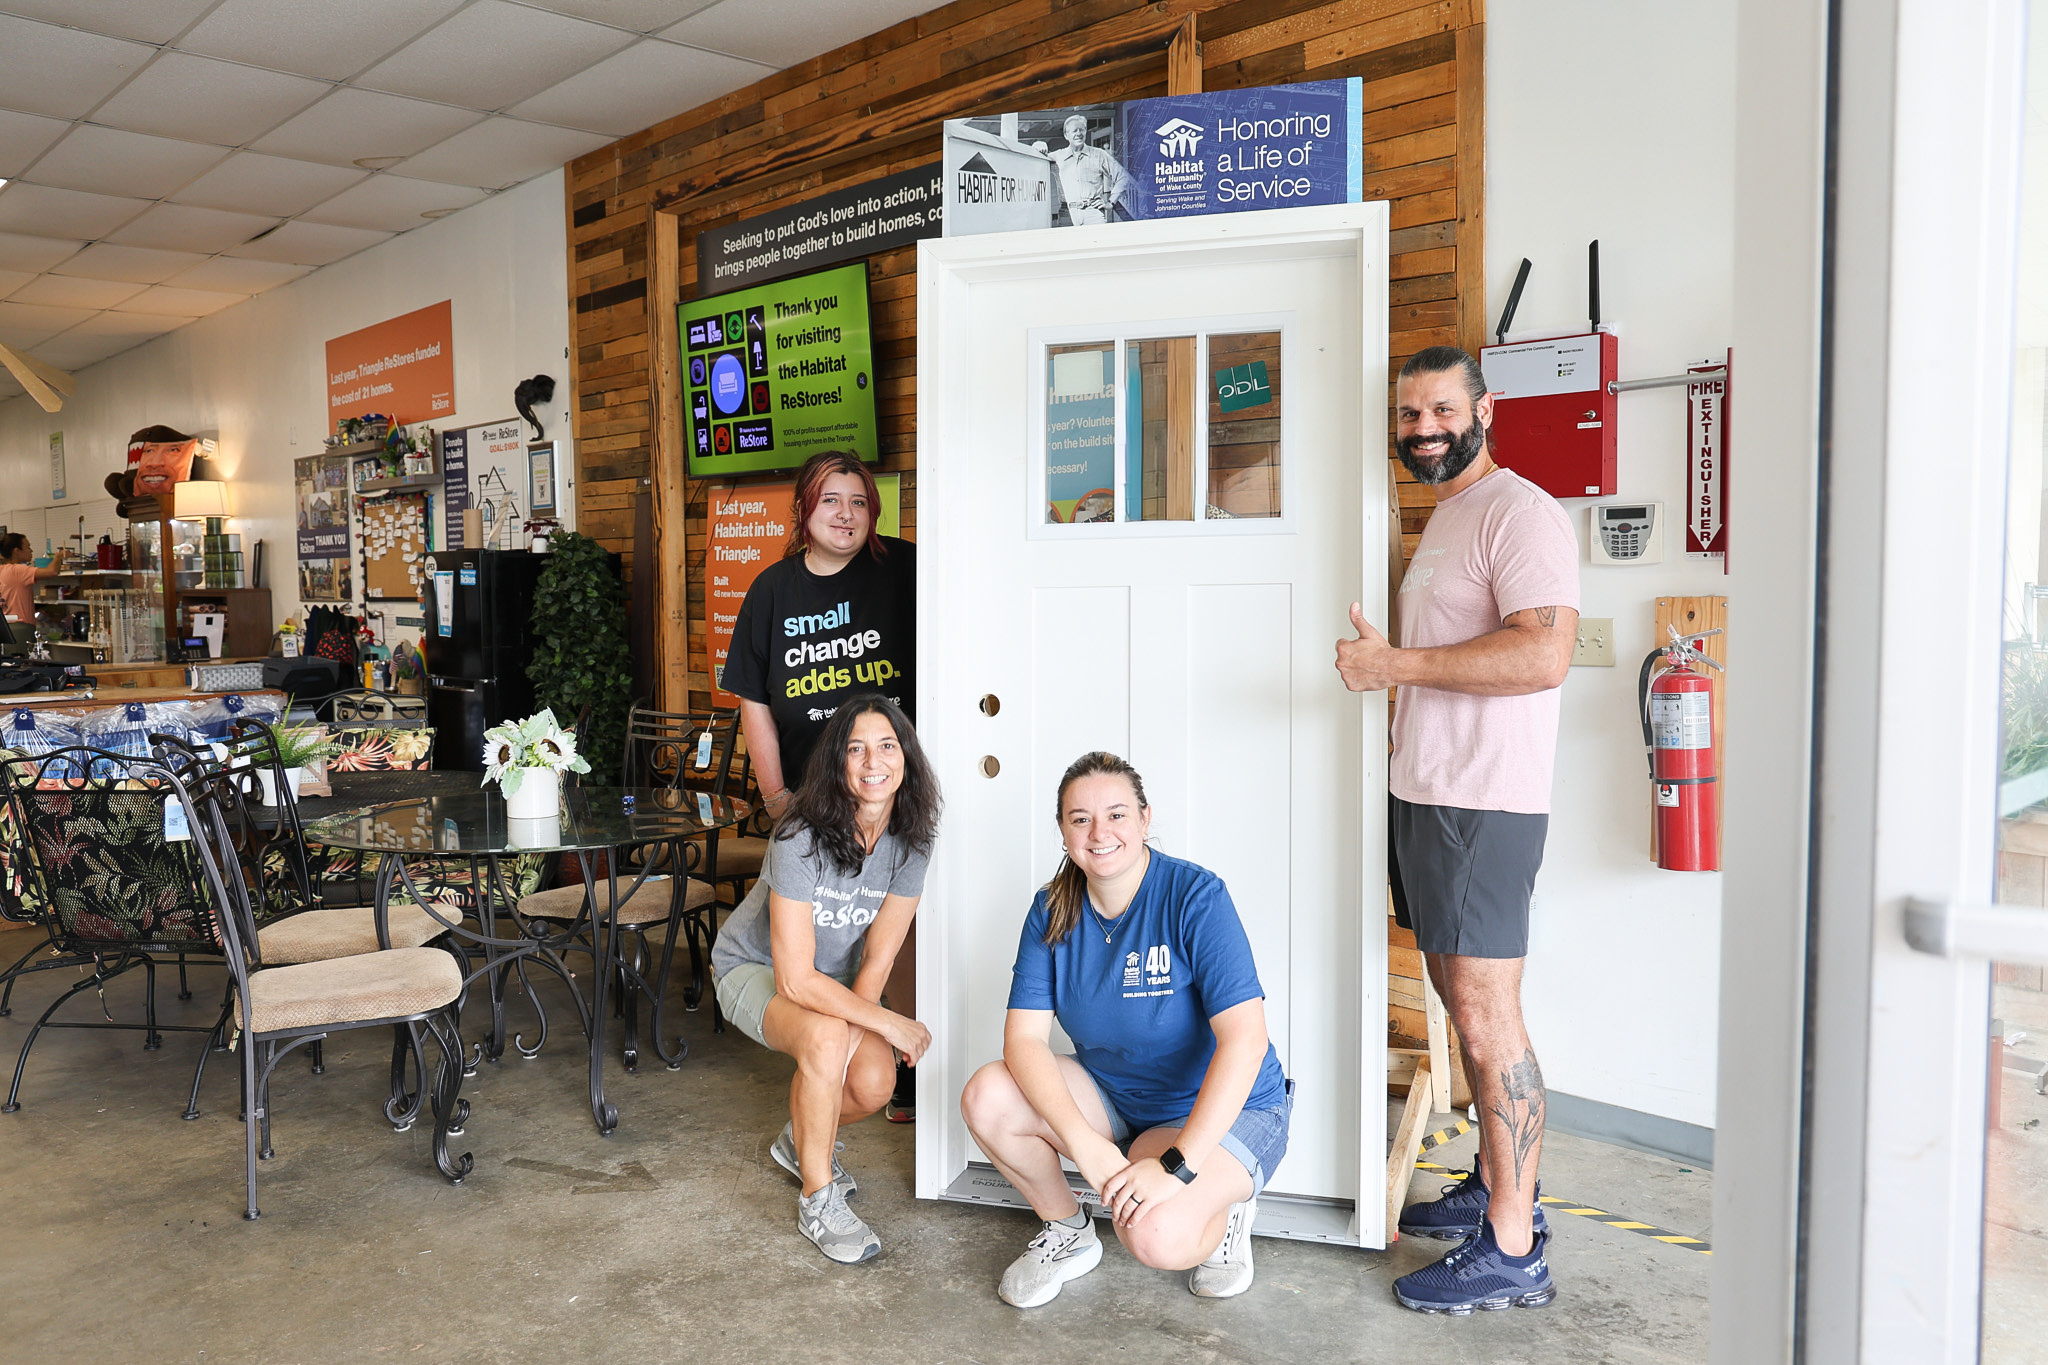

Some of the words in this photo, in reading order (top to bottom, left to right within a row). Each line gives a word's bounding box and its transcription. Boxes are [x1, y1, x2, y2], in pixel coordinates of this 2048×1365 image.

[1218, 112, 1330, 142] Honoring
[1156, 160, 1204, 176] Habitat
[1217, 154, 1233, 172] a
[1238, 145, 1282, 171] Life
[1287, 141, 1312, 166] of
[958, 172, 997, 204] HABITAT
[1001, 177, 1016, 203] FOR
[1018, 178, 1047, 203] HUMANITY
[1217, 175, 1310, 202] Service
[723, 231, 762, 255] Seeking
[764, 228, 776, 243] to
[777, 220, 795, 242] put
[830, 203, 854, 224] love
[857, 197, 881, 216] into
[884, 184, 928, 209] action,
[931, 177, 943, 196] H
[714, 258, 744, 279] brings
[746, 248, 780, 273] people
[782, 234, 829, 261] together
[832, 231, 844, 247] to
[846, 222, 876, 244] build
[878, 211, 925, 235] homes,
[774, 297, 813, 319] Thank
[814, 295, 838, 313] you
[776, 333, 793, 350] for
[796, 326, 841, 346] visiting
[330, 370, 343, 385] Last
[359, 360, 384, 378] Triangle
[384, 352, 414, 370] ReStores
[416, 341, 440, 360] funded
[778, 361, 798, 380] the
[800, 355, 847, 377] Habitat
[332, 394, 341, 407] the
[342, 391, 354, 405] cost
[362, 387, 370, 399] 21
[371, 382, 394, 396] homes.
[781, 386, 842, 410] ReStores!
[1219, 378, 1270, 398] ODL
[1691, 382, 1723, 396] FIRE
[1052, 418, 1076, 434] year?
[445, 437, 463, 448] Donate
[740, 434, 768, 448] ReStore
[1052, 441, 1062, 450] on
[1064, 438, 1078, 449] the
[1080, 435, 1100, 447] build
[1700, 398, 1712, 542] EXTINGUISHER
[716, 500, 739, 516] Last
[739, 500, 767, 517] year,
[315, 535, 333, 546] THANK
[333, 534, 346, 545] YOU
[715, 521, 753, 538] Habitat
[754, 522, 764, 537] in
[766, 520, 784, 536] the
[714, 546, 760, 564] Triangle:
[714, 576, 728, 586] Built
[784, 600, 850, 637] small
[784, 629, 881, 668] change
[786, 665, 851, 698] adds
[855, 658, 901, 686] up.
[1145, 944, 1170, 975] 40
[1147, 976, 1170, 985] YEARS
